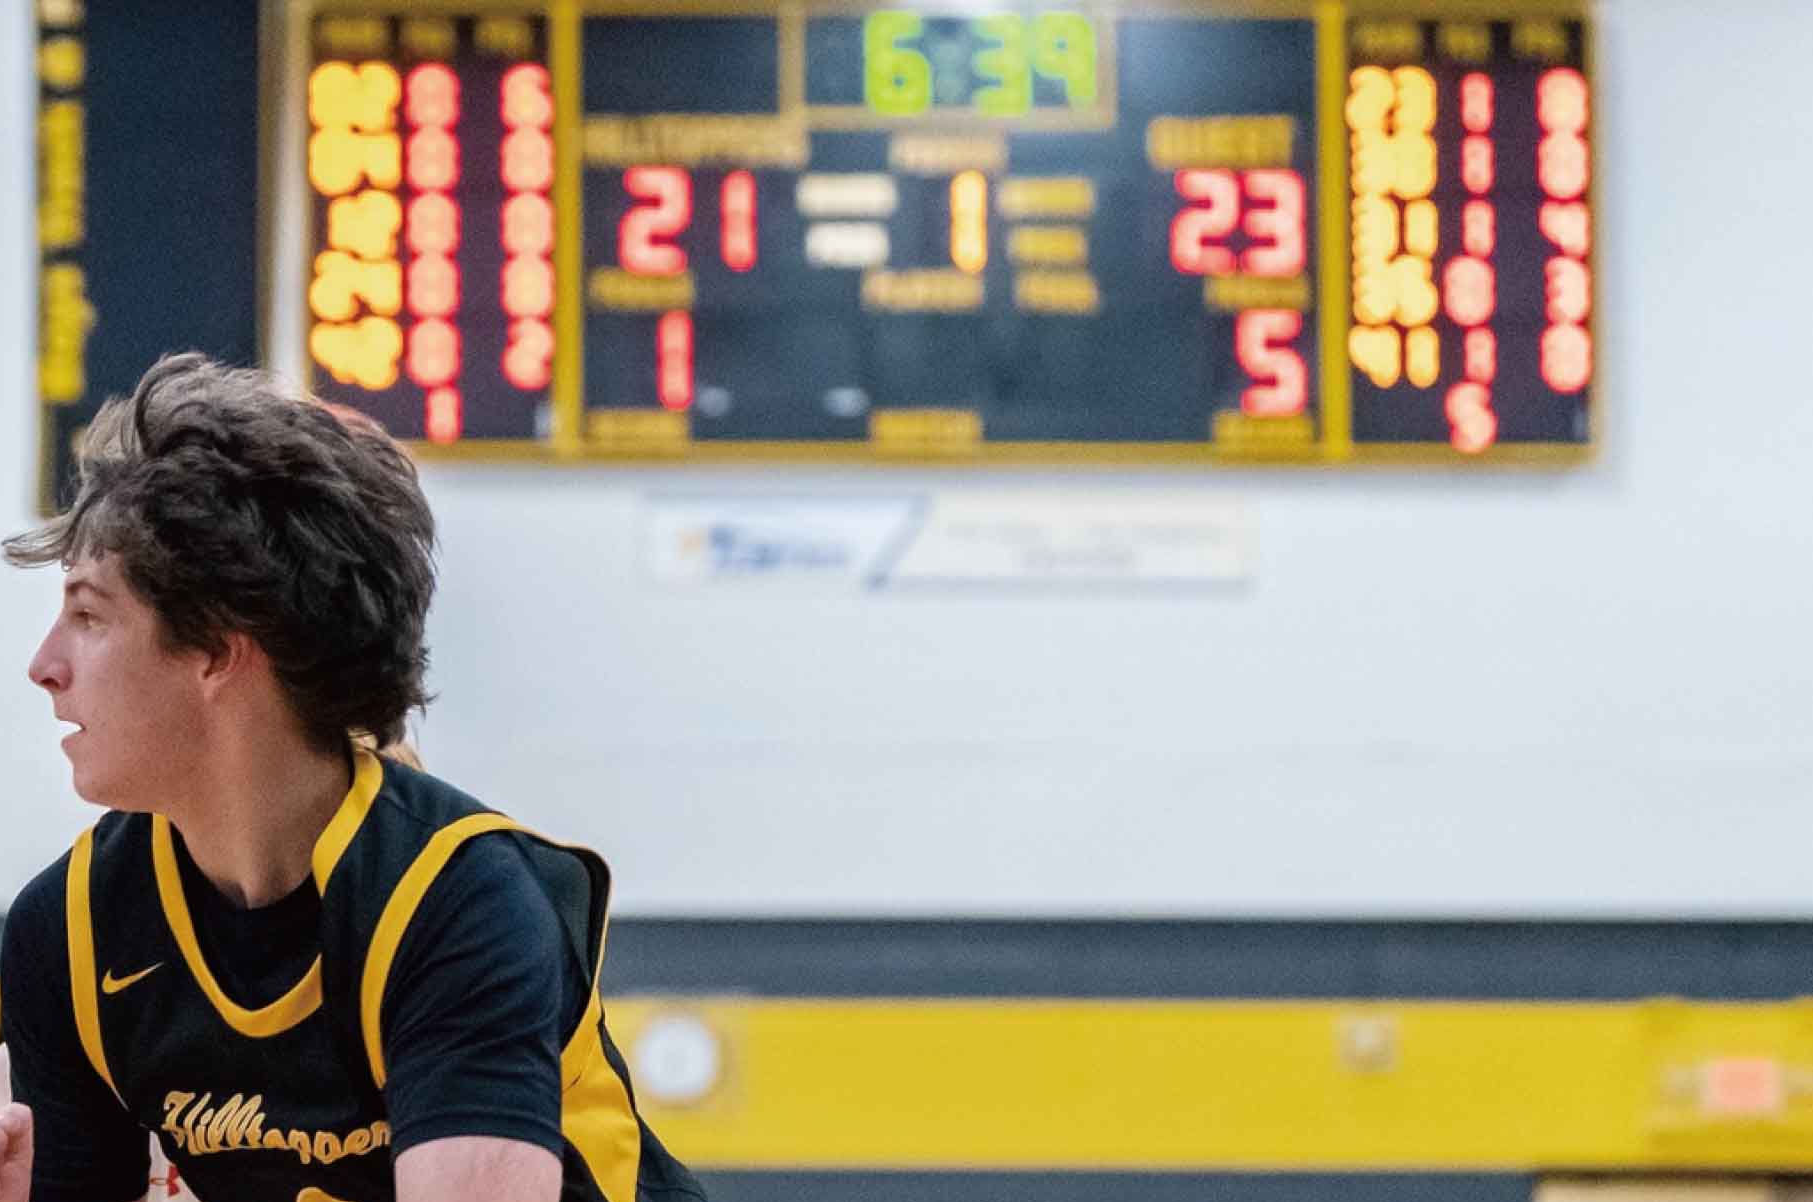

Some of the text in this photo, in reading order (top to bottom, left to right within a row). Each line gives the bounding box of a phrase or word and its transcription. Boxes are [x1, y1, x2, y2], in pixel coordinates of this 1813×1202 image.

[618, 163, 758, 272] 21
[949, 168, 987, 273] 1
[1168, 167, 1308, 276] 23
[655, 308, 694, 411] 1
[1234, 307, 1308, 416] 5
